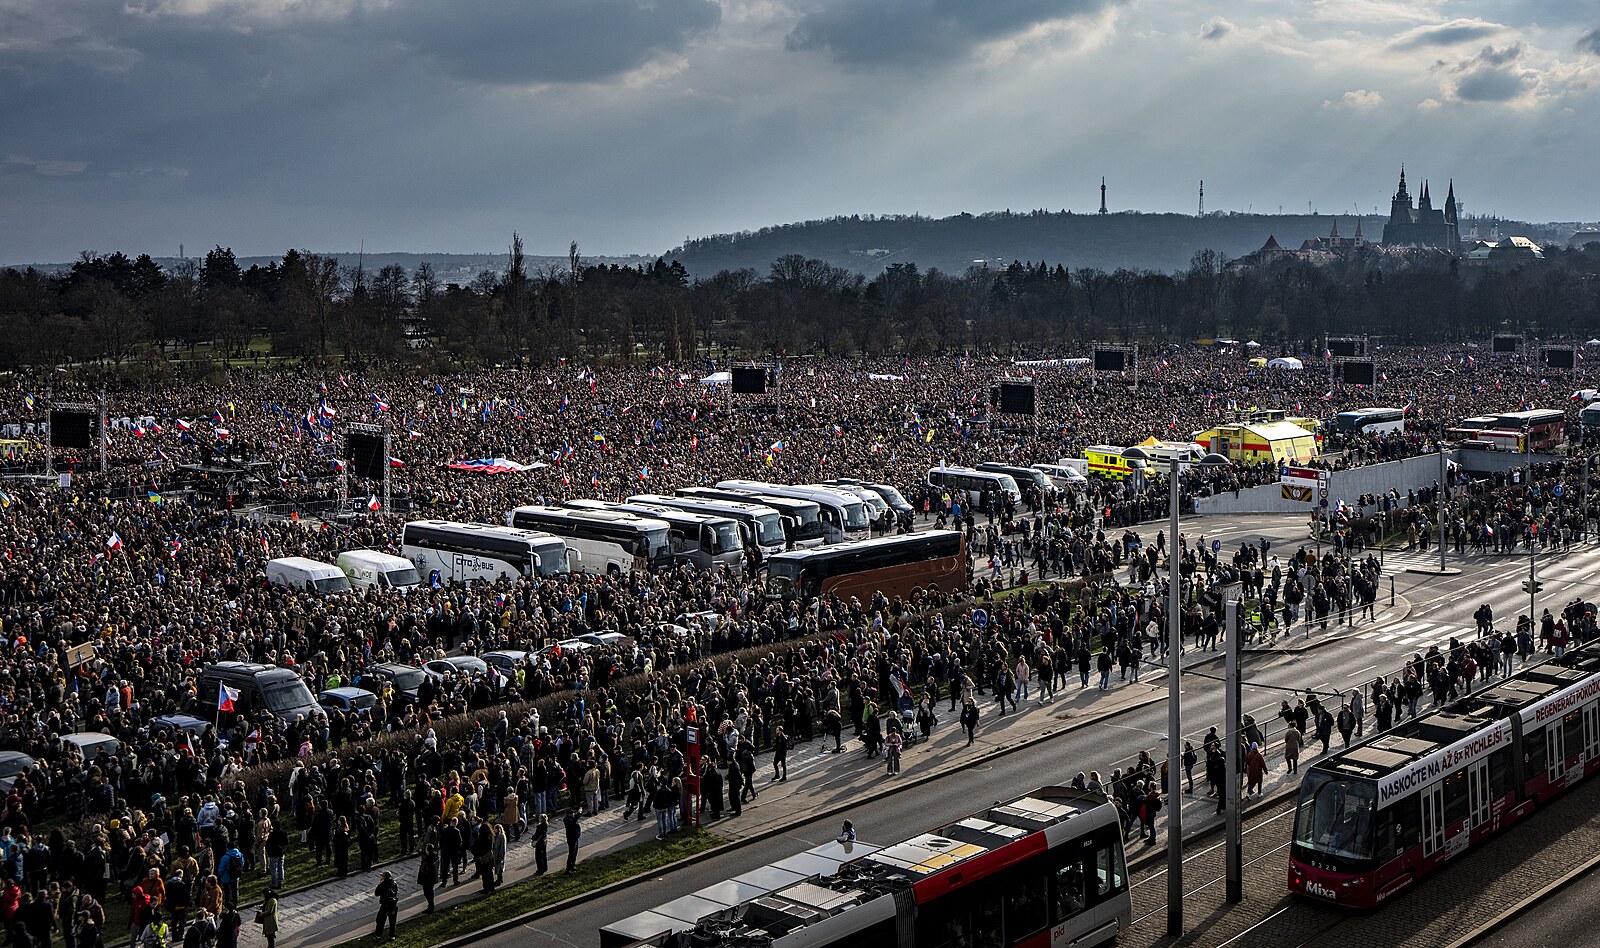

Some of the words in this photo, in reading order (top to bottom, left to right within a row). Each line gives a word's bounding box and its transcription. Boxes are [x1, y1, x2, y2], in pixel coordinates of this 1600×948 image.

[481, 561, 494, 571] BUS
[1380, 767, 1427, 803] NASKOČTE
[1427, 760, 1440, 778] NA
[1441, 749, 1453, 772] AŽ
[1463, 725, 1503, 760] RYCHLEJŠÍ
[1311, 860, 1337, 872] 9328
[1306, 879, 1337, 900] Mixa
[1053, 925, 1065, 941] pid
